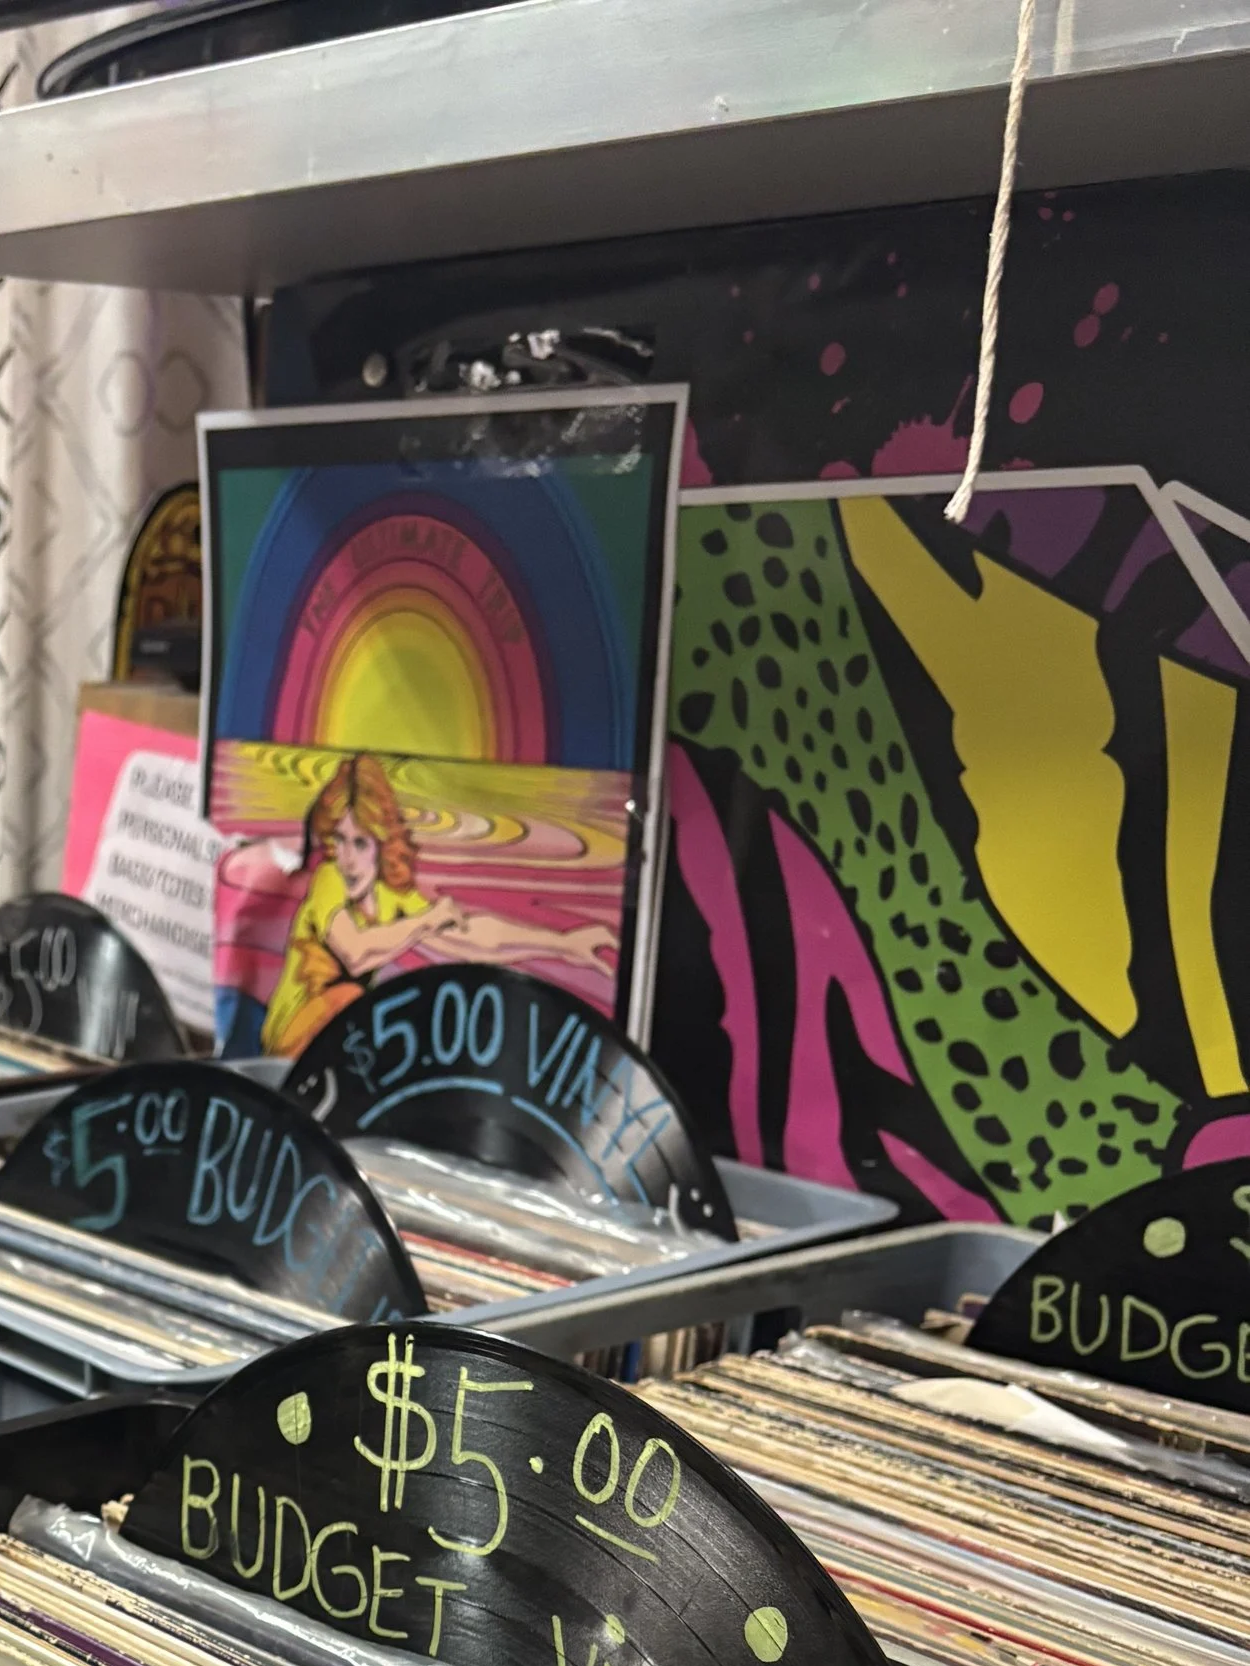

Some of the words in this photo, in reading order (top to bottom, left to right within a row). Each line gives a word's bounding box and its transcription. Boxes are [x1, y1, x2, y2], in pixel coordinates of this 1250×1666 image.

[343, 980, 506, 1093] $5.00
[527, 1002, 674, 1206] VINYL
[179, 1454, 468, 1656] BUDGET
[353, 1333, 683, 1558] $5.00
